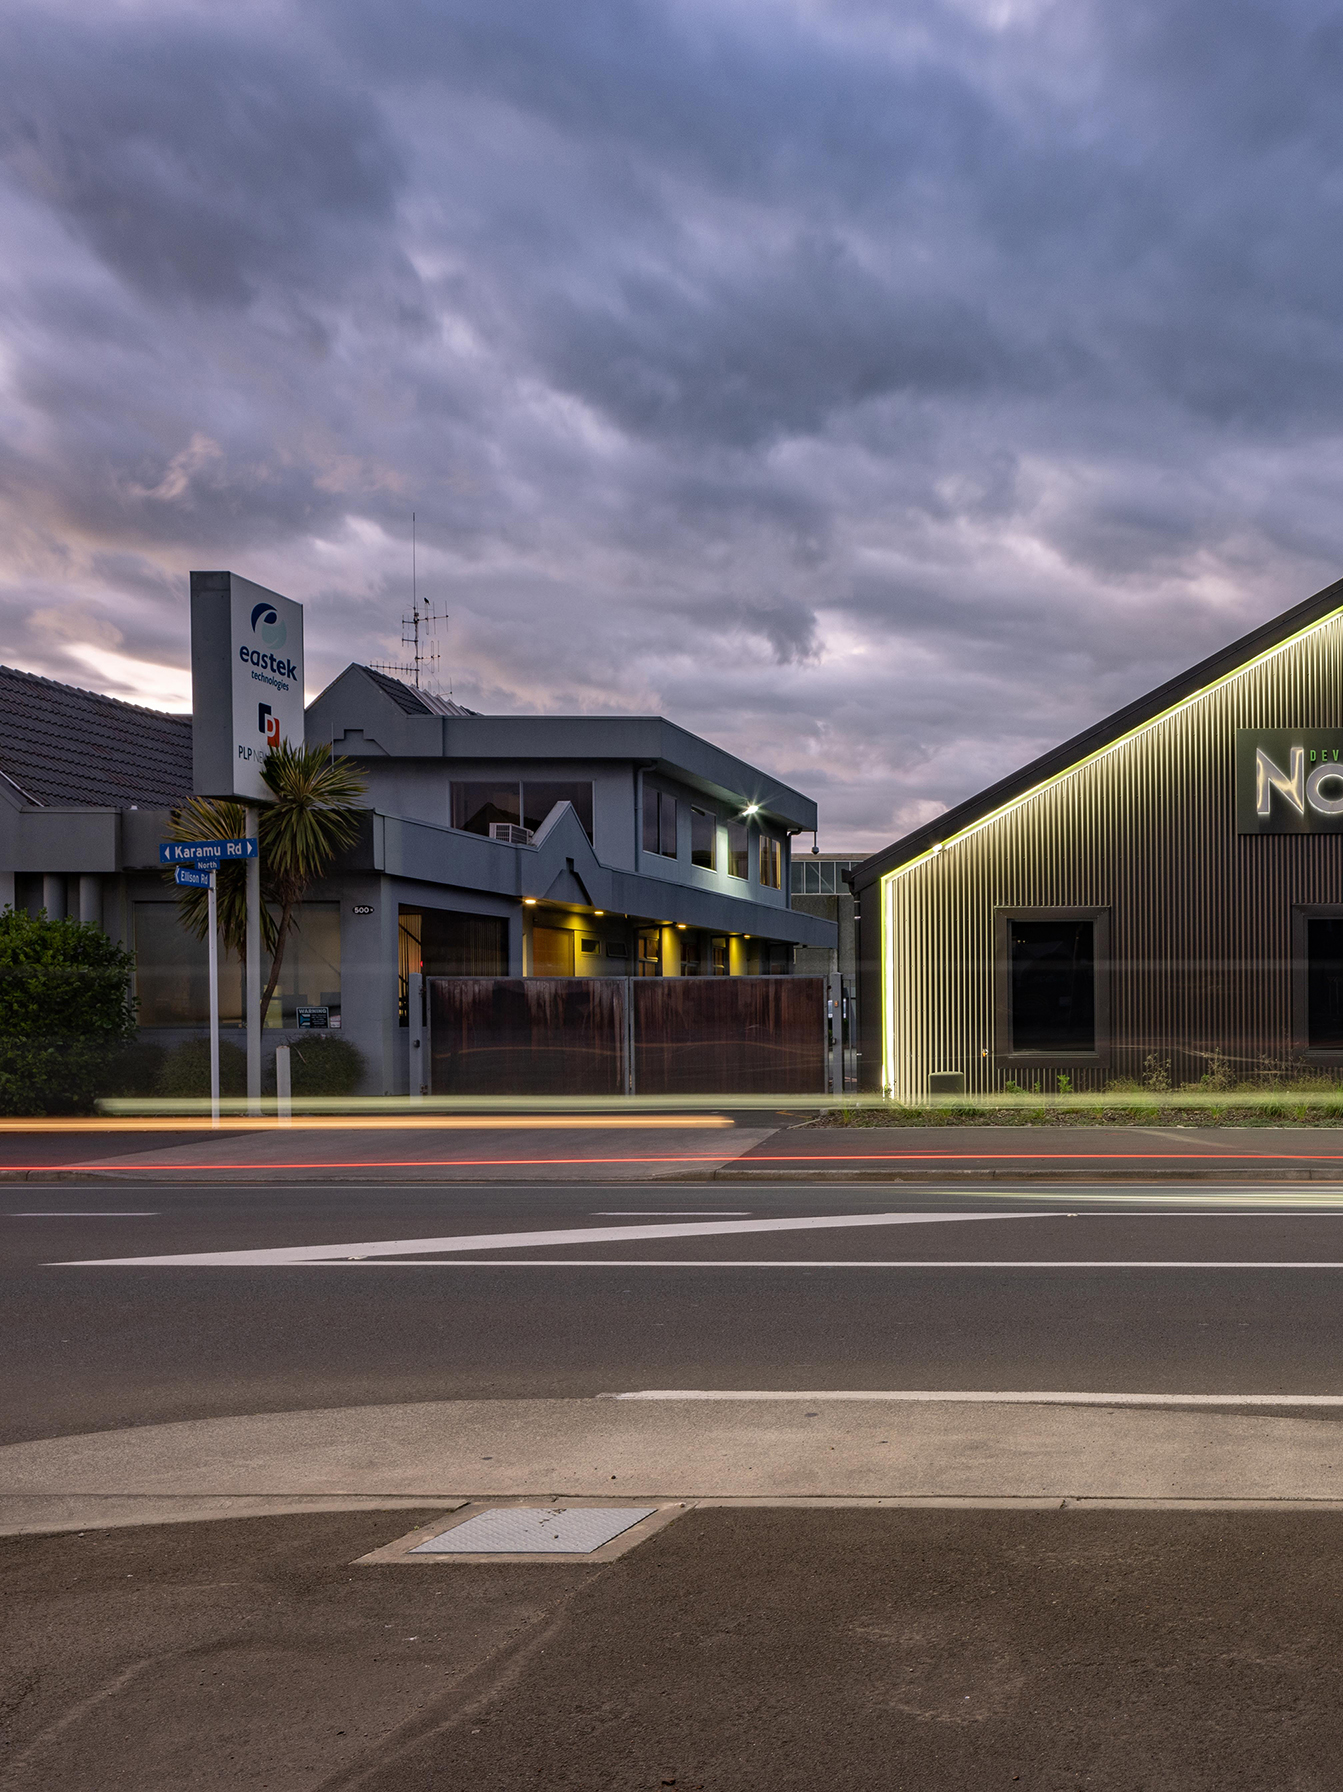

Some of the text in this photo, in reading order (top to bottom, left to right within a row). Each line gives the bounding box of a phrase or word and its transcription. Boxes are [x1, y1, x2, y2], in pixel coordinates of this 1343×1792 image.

[239, 645, 298, 682] eastek
[251, 670, 289, 691] technologies
[238, 744, 252, 761] PLP
[174, 842, 242, 859] Karamu Rd
[197, 861, 218, 870] North
[180, 870, 208, 886] Ellison Rd
[354, 906, 370, 914] 500
